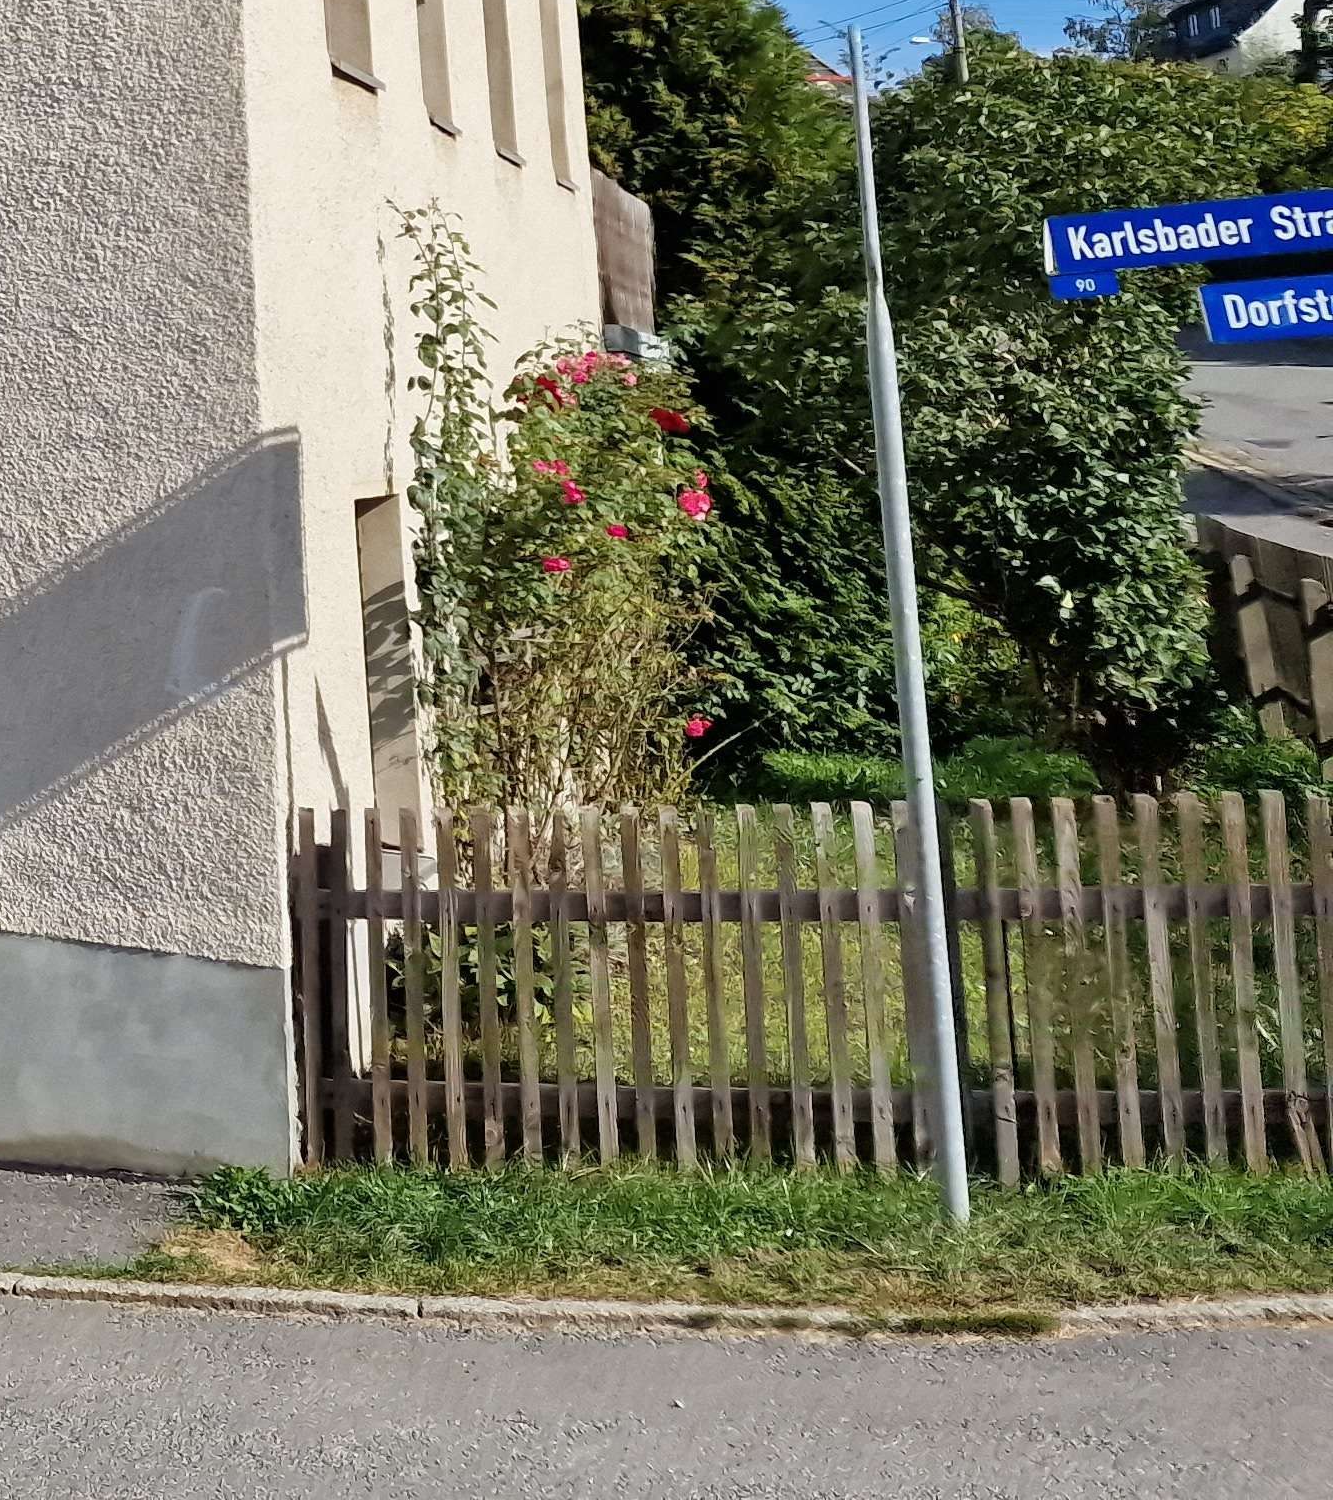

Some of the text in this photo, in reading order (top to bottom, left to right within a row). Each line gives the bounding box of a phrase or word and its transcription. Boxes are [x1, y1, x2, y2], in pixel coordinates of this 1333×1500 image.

[1067, 212, 1254, 260] Karlsbader
[1075, 278, 1096, 293] 90
[1222, 289, 1333, 329] Dorfst
